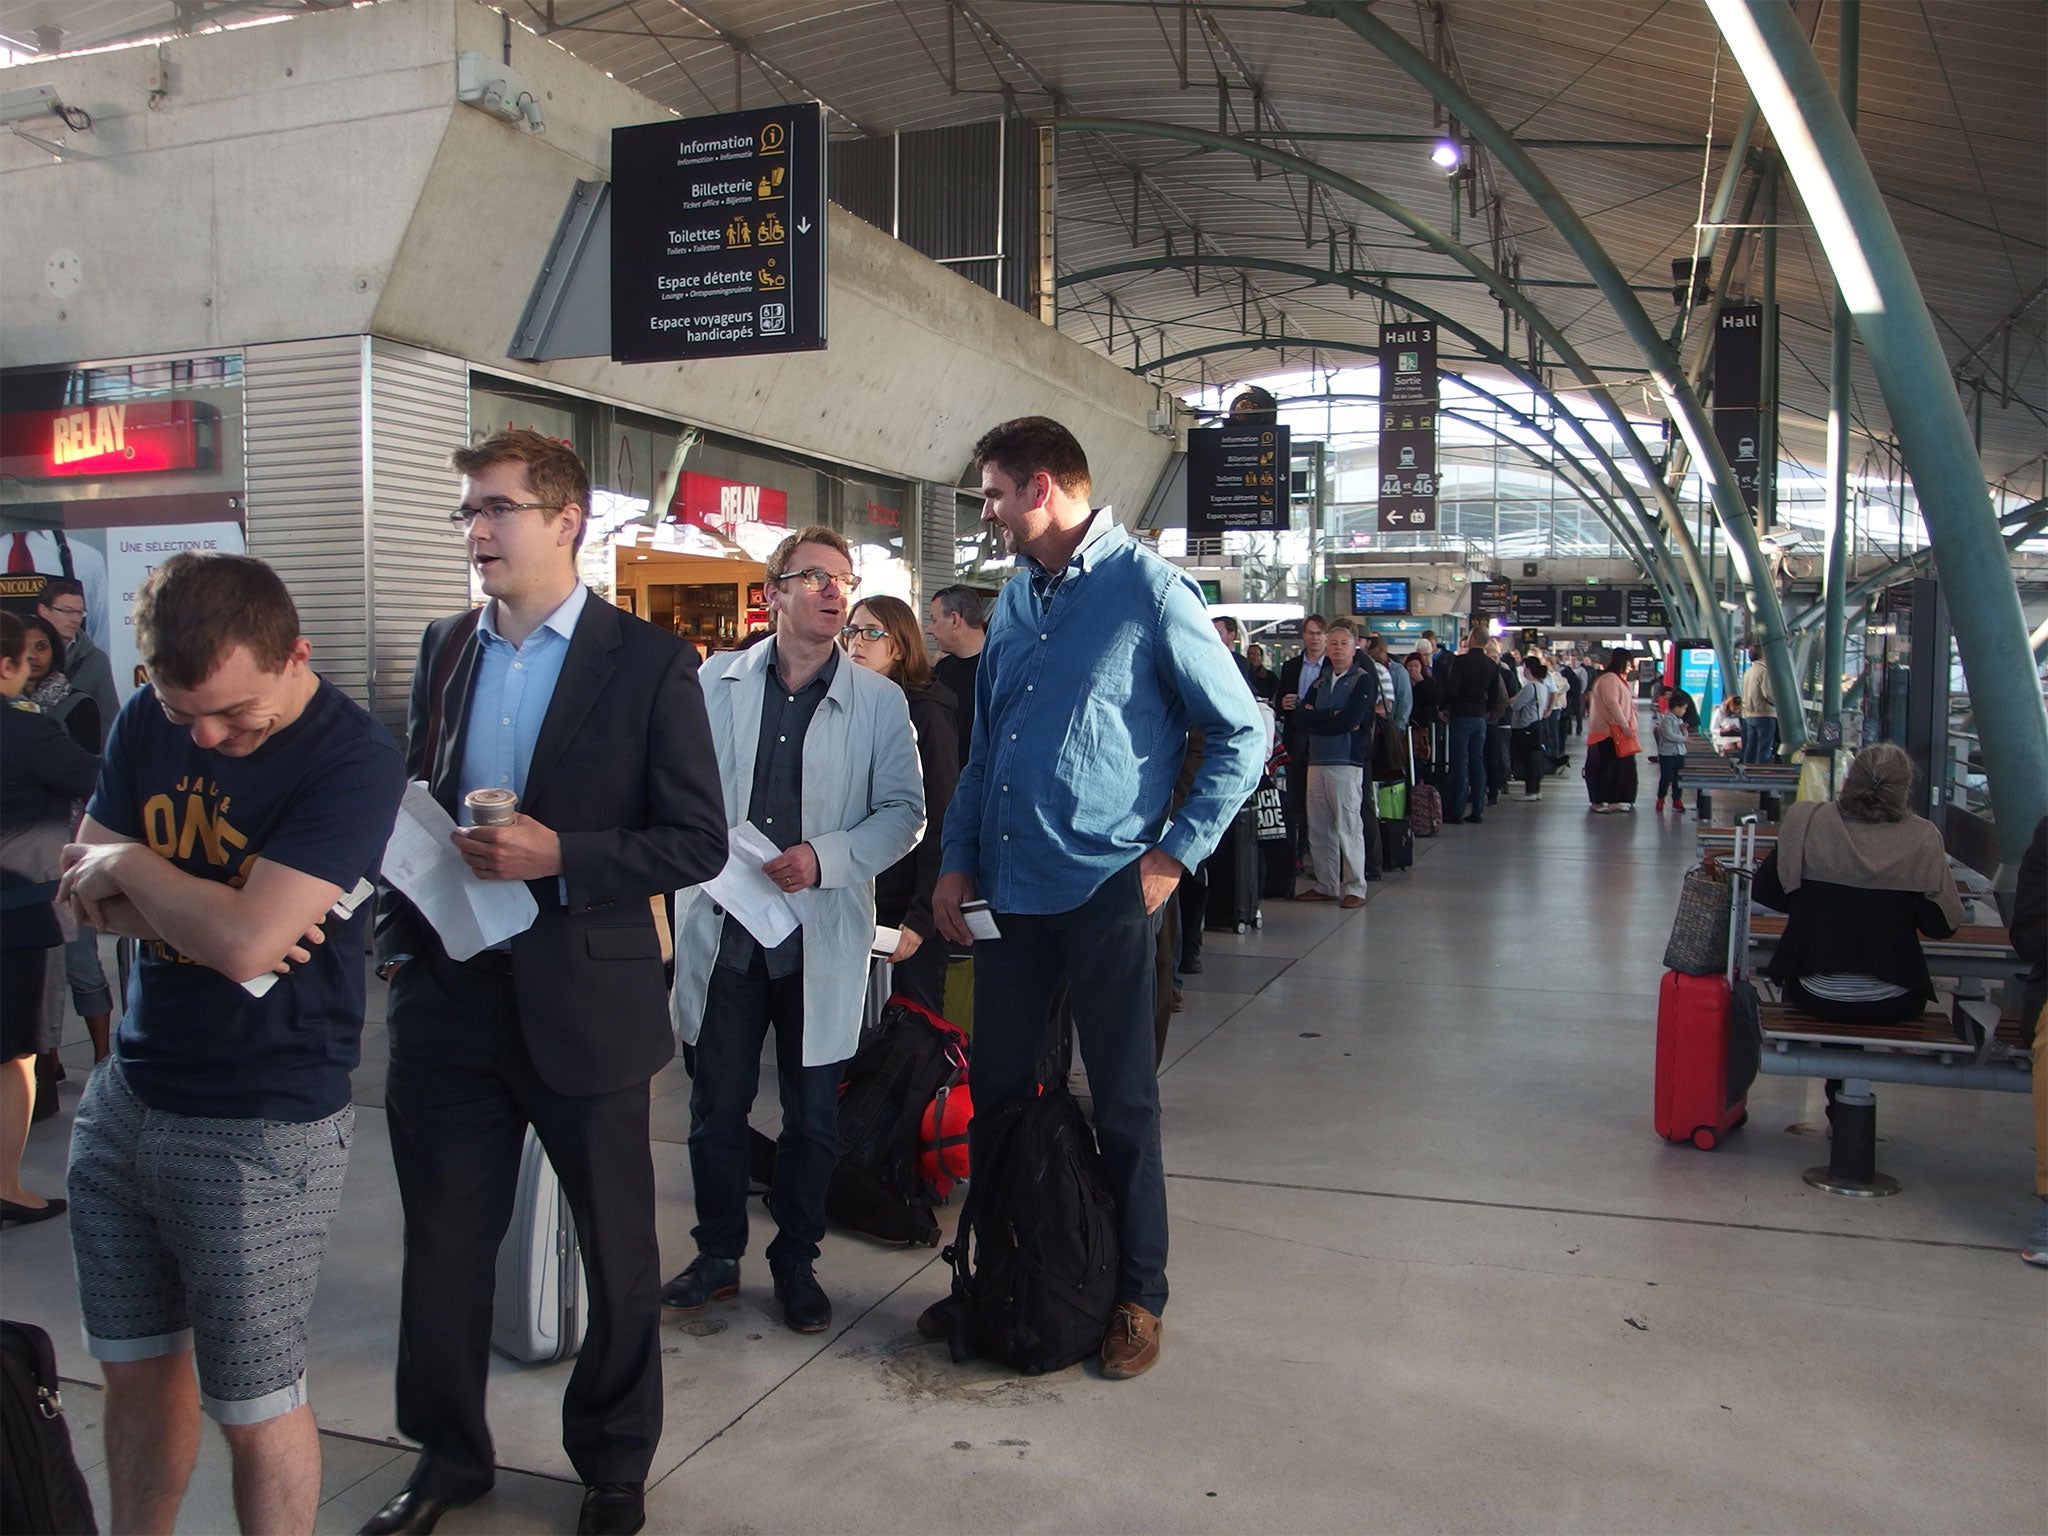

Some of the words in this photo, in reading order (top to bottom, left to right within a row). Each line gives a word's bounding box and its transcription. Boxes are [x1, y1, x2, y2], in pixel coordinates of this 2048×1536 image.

[680, 135, 753, 155] Information
[677, 155, 714, 166] Information
[691, 178, 752, 197] Billetterie
[683, 201, 701, 210] Ticket
[702, 199, 720, 208] office
[668, 229, 720, 244] Toilettes
[667, 246, 687, 256] Toilets
[658, 276, 700, 291] Espace
[703, 269, 752, 286] détente
[661, 291, 684, 301] Lounge
[650, 316, 690, 331] Espace
[693, 311, 754, 327] voyageurs
[1722, 315, 1758, 328] Hall
[687, 325, 754, 342] handicapés
[1385, 330, 1417, 343] Hall
[1422, 330, 1431, 342] 3
[1394, 376, 1422, 386] Sortie
[54, 404, 126, 464] RELAY
[1381, 480, 1402, 494] 44
[1412, 480, 1433, 494] 46
[721, 486, 760, 522] RELAY
